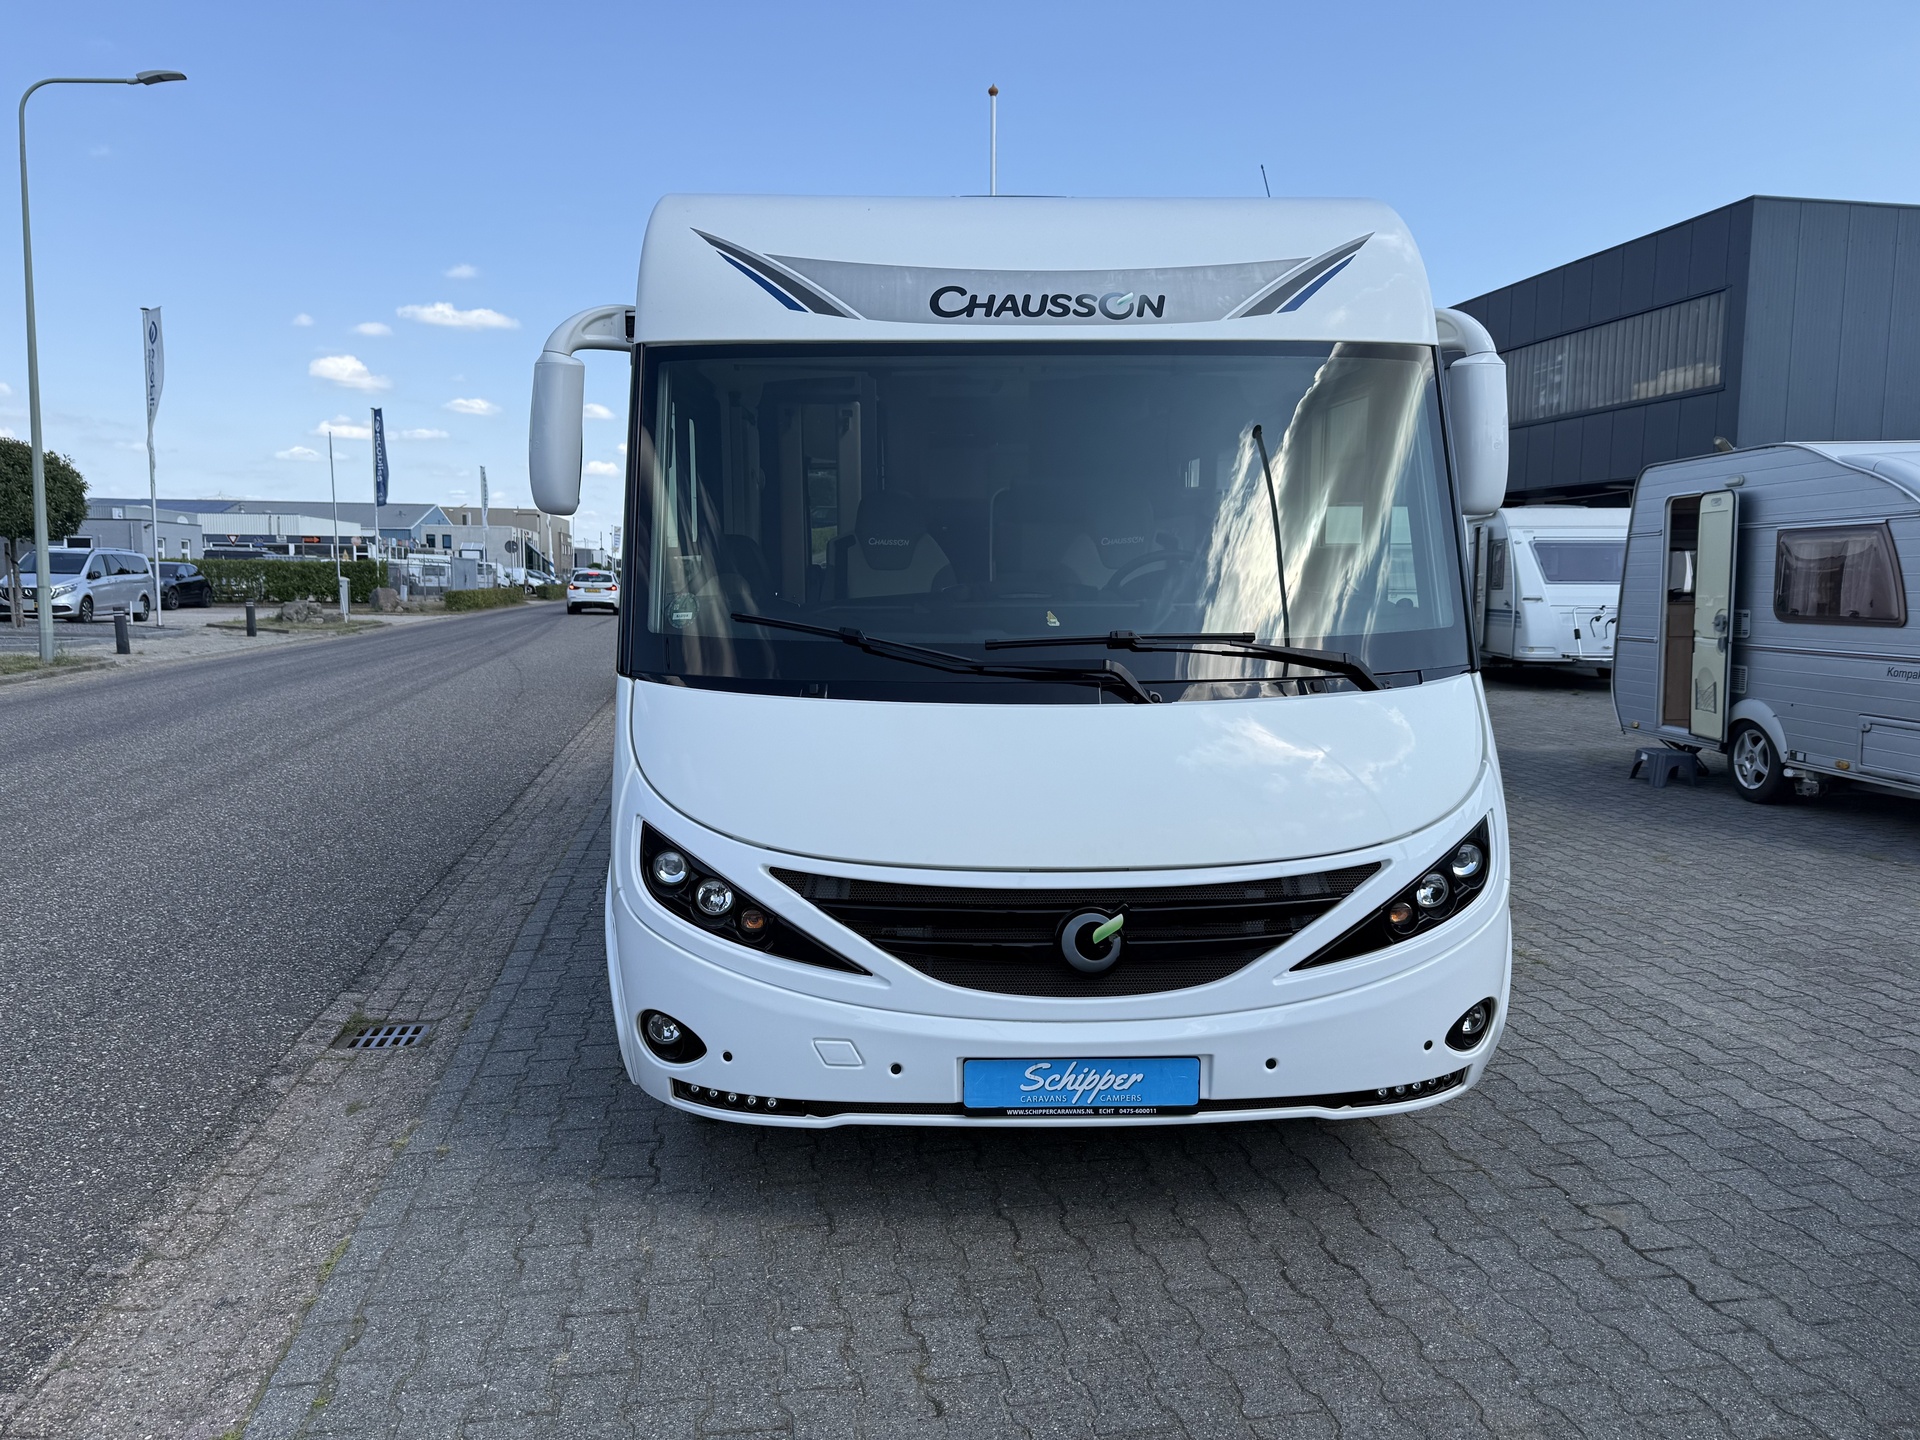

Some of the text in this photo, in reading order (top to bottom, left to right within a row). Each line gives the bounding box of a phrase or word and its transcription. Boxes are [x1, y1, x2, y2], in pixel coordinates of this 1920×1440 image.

[929, 285, 1166, 321] CHAUSSON
[868, 537, 910, 546] CHAUSSON
[1019, 1061, 1144, 1104] Schipper
[1020, 1094, 1142, 1103] CARAVANS CAMPERS
